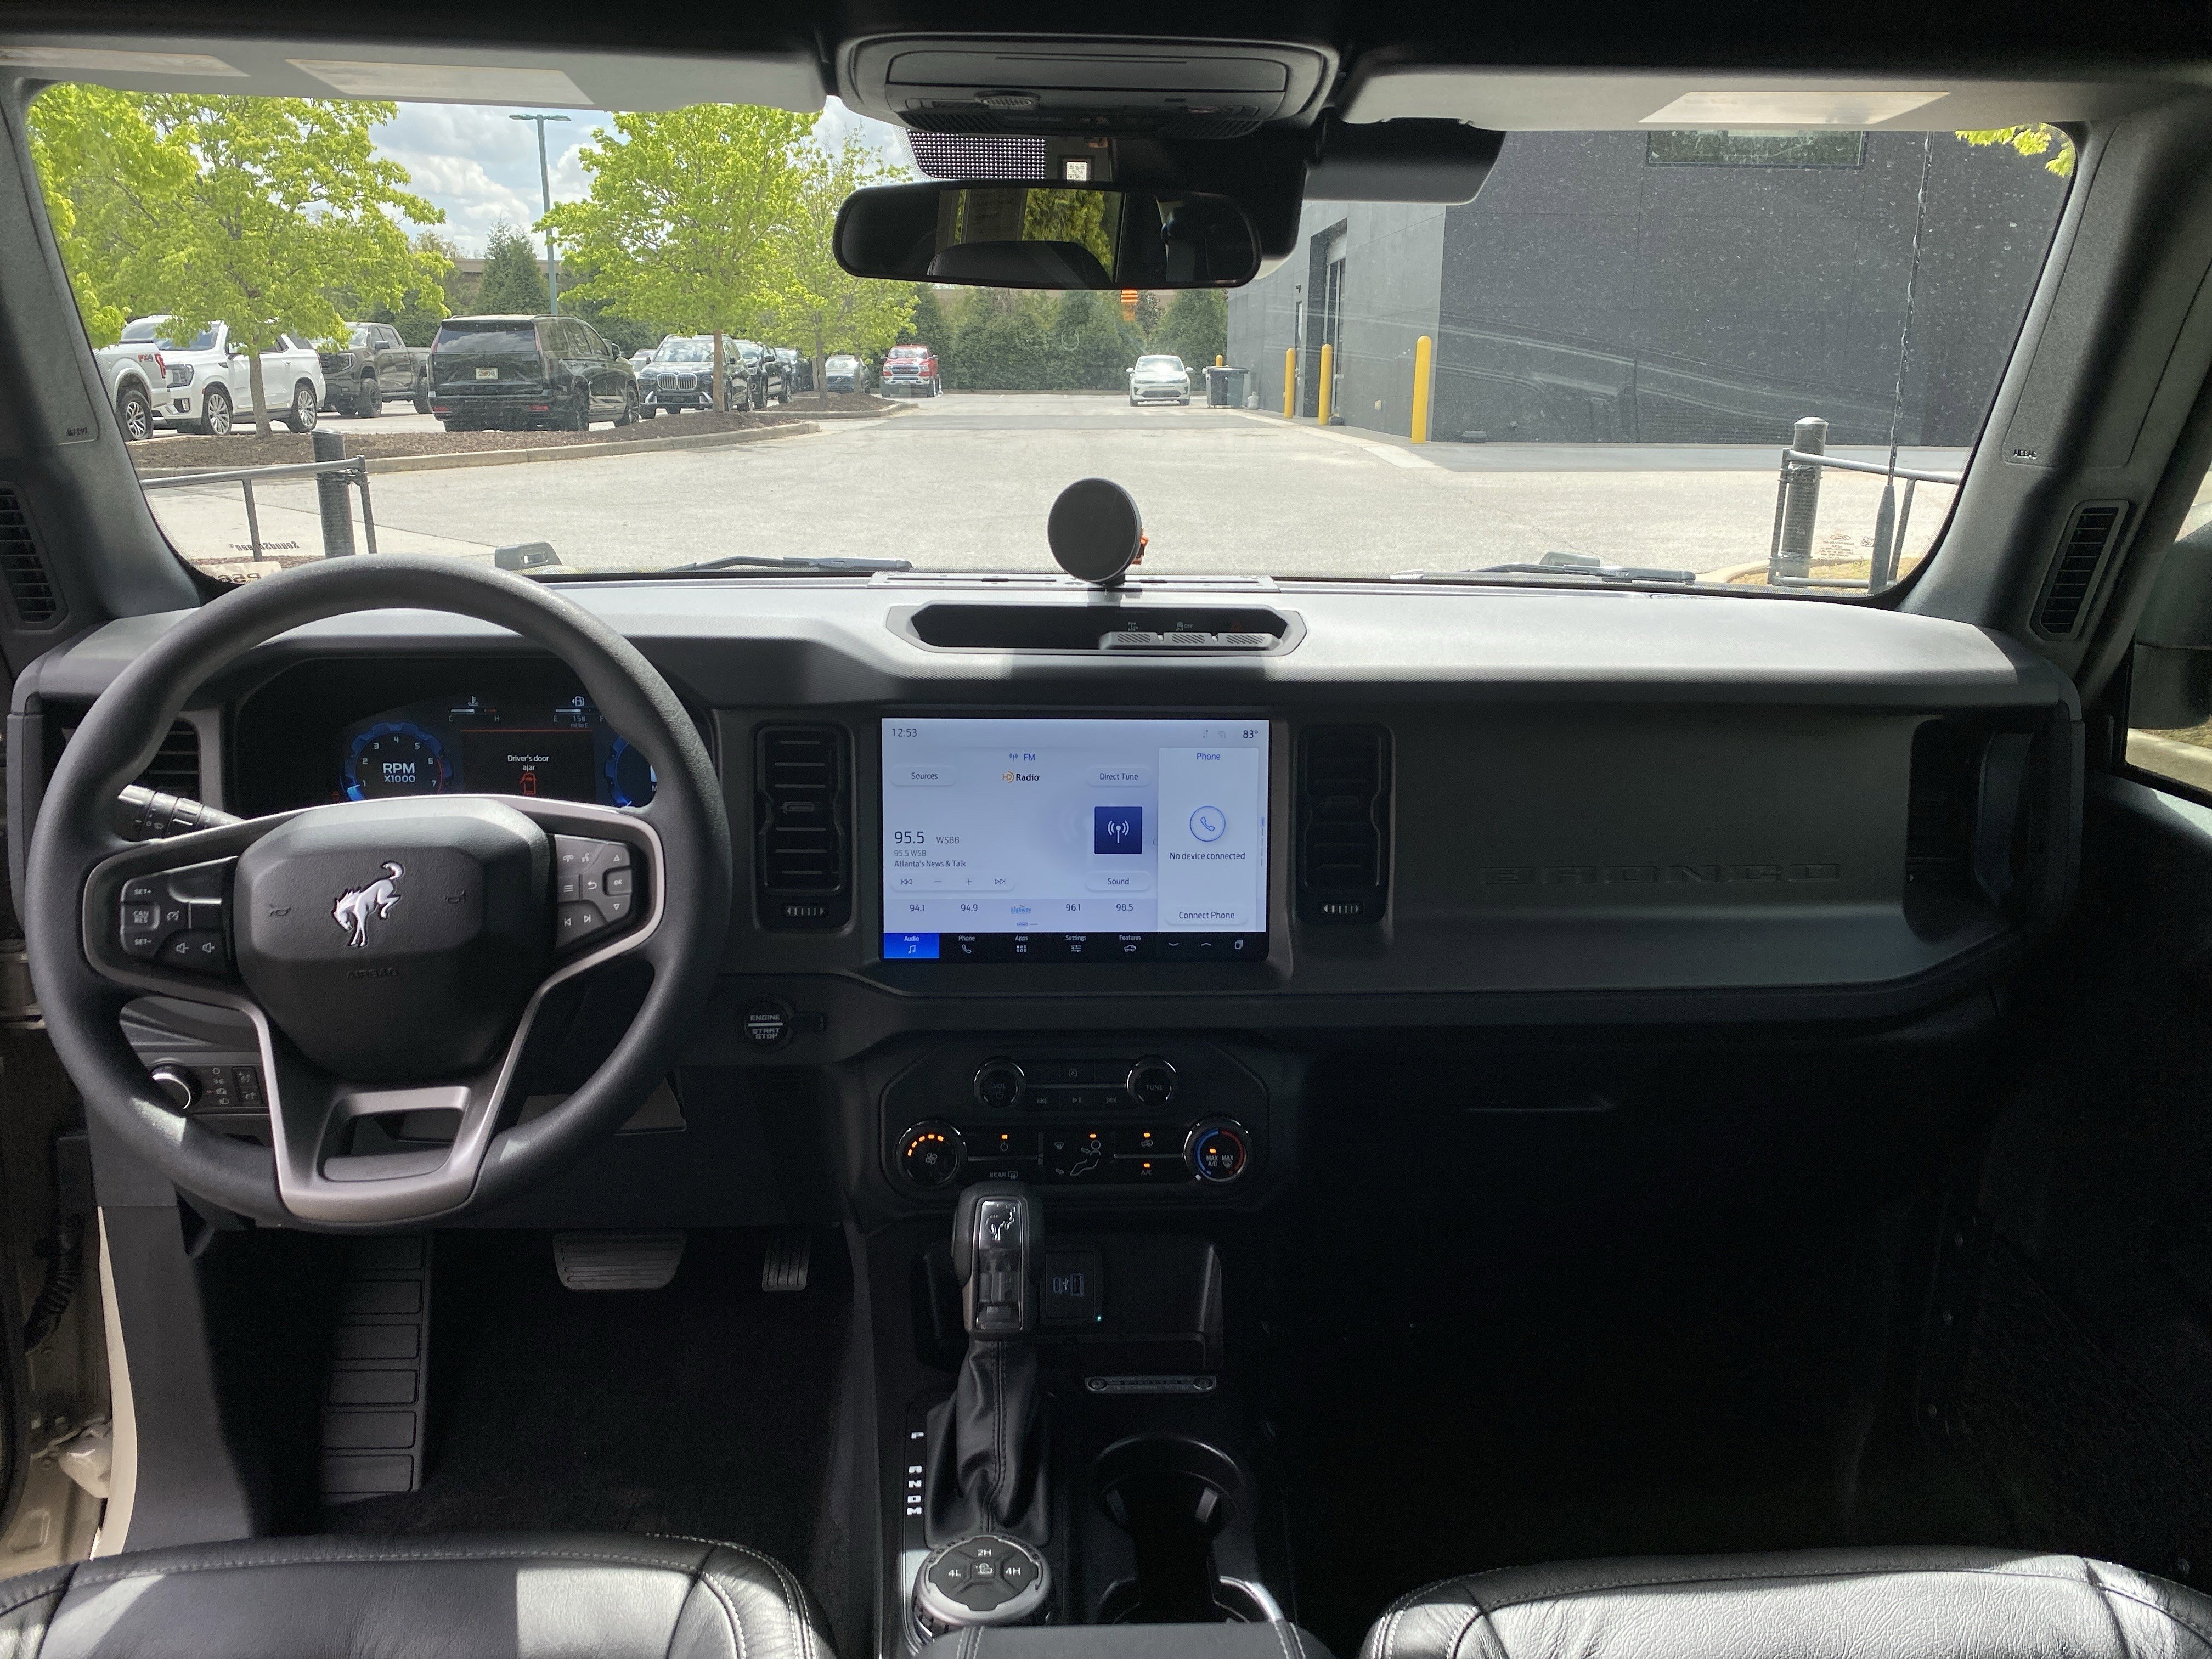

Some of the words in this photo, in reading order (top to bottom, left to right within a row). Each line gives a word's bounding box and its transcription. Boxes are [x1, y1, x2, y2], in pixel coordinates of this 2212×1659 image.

[892, 729, 917, 737] 12:53
[1243, 730, 1258, 738] 83°
[383, 763, 415, 774] RPM
[522, 764, 535, 772] ajar
[895, 831, 924, 844] 95.5
[1181, 851, 1205, 860] device
[1206, 851, 1245, 860] connected
[1480, 863, 1841, 885] BRONCO
[1179, 911, 1209, 920] Connect
[1211, 911, 1234, 920] Phone
[346, 967, 399, 980] AIRBAG
[908, 1480, 922, 1488] N
[907, 1506, 922, 1515] M
[978, 1549, 992, 1557] 2H
[1005, 1567, 1021, 1576] 4H
